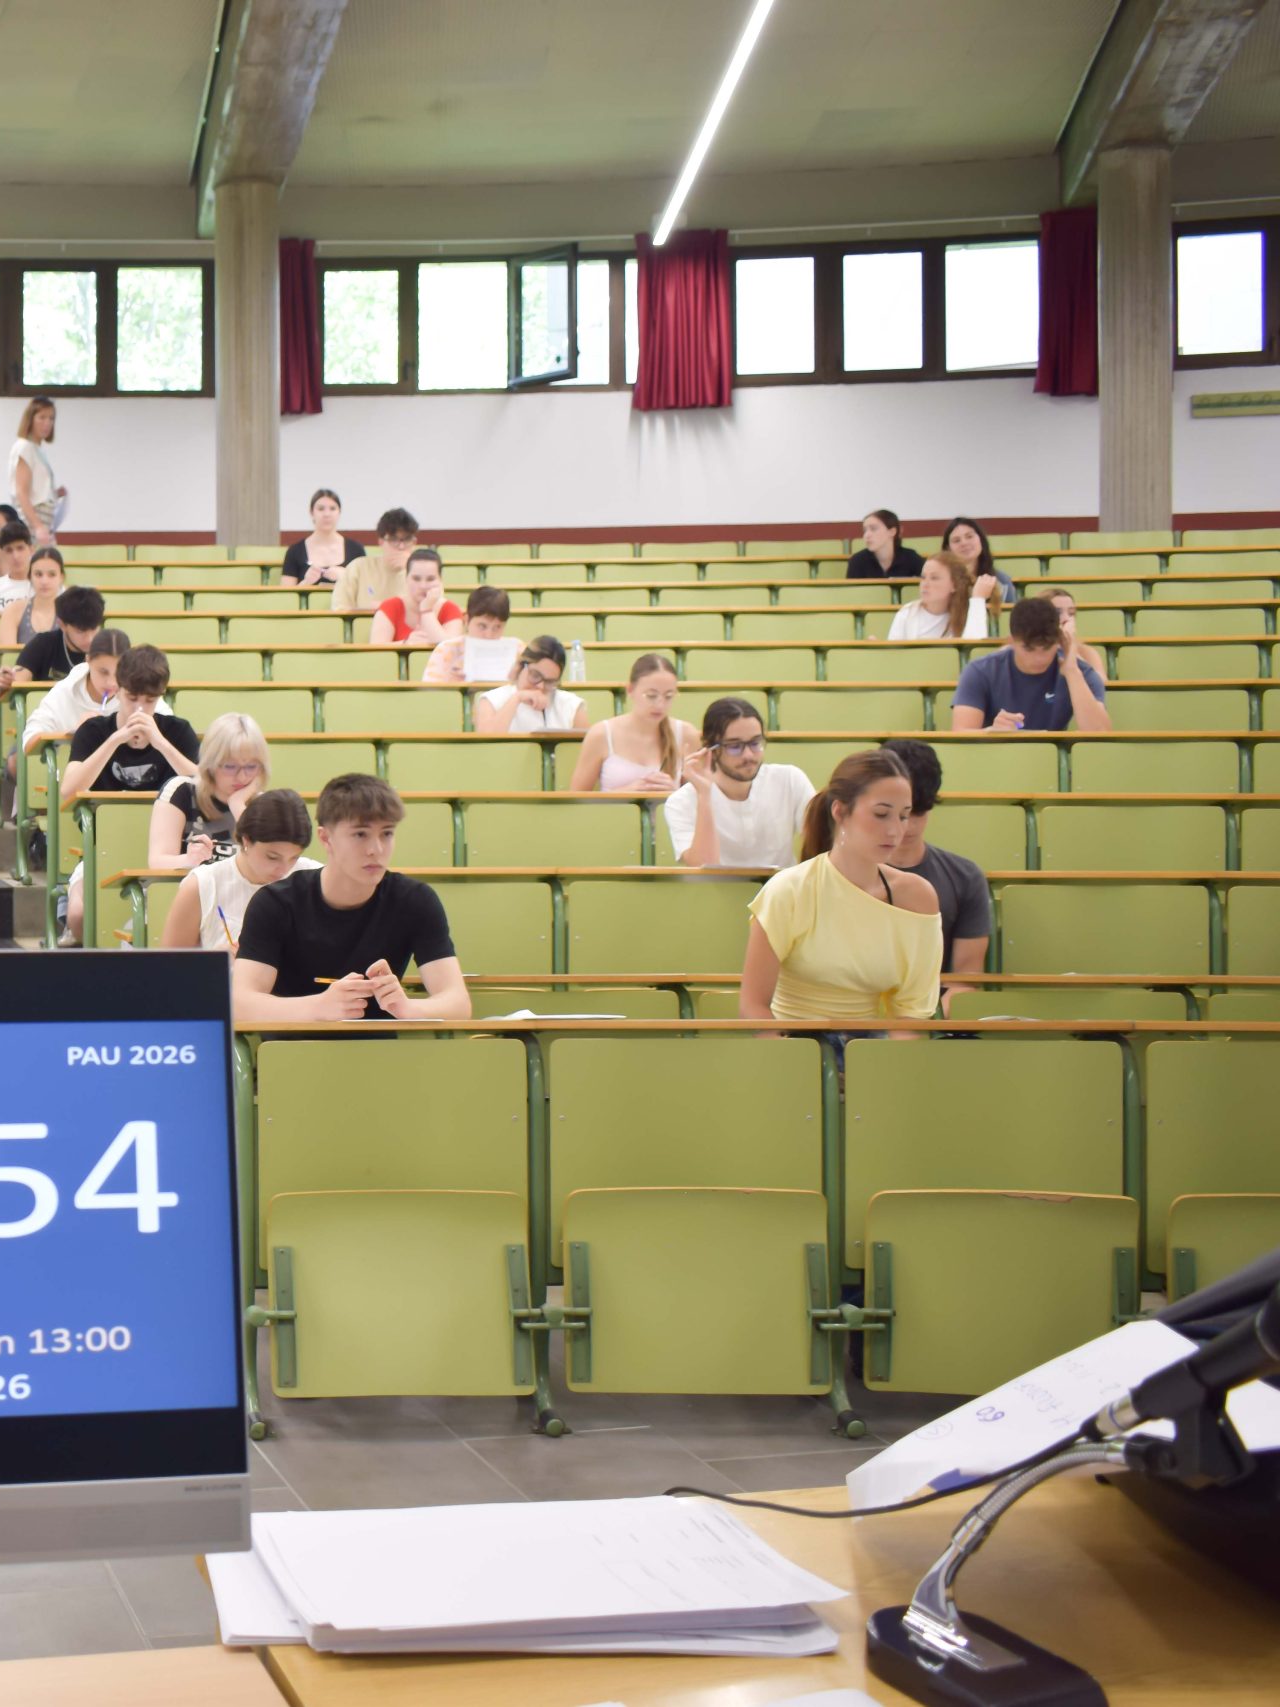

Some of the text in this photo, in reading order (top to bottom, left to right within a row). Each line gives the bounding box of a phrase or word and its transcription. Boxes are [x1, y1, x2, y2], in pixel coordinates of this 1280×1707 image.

[67, 1044, 197, 1066] PAU 2026
[29, 1325, 132, 1355] 13:00
